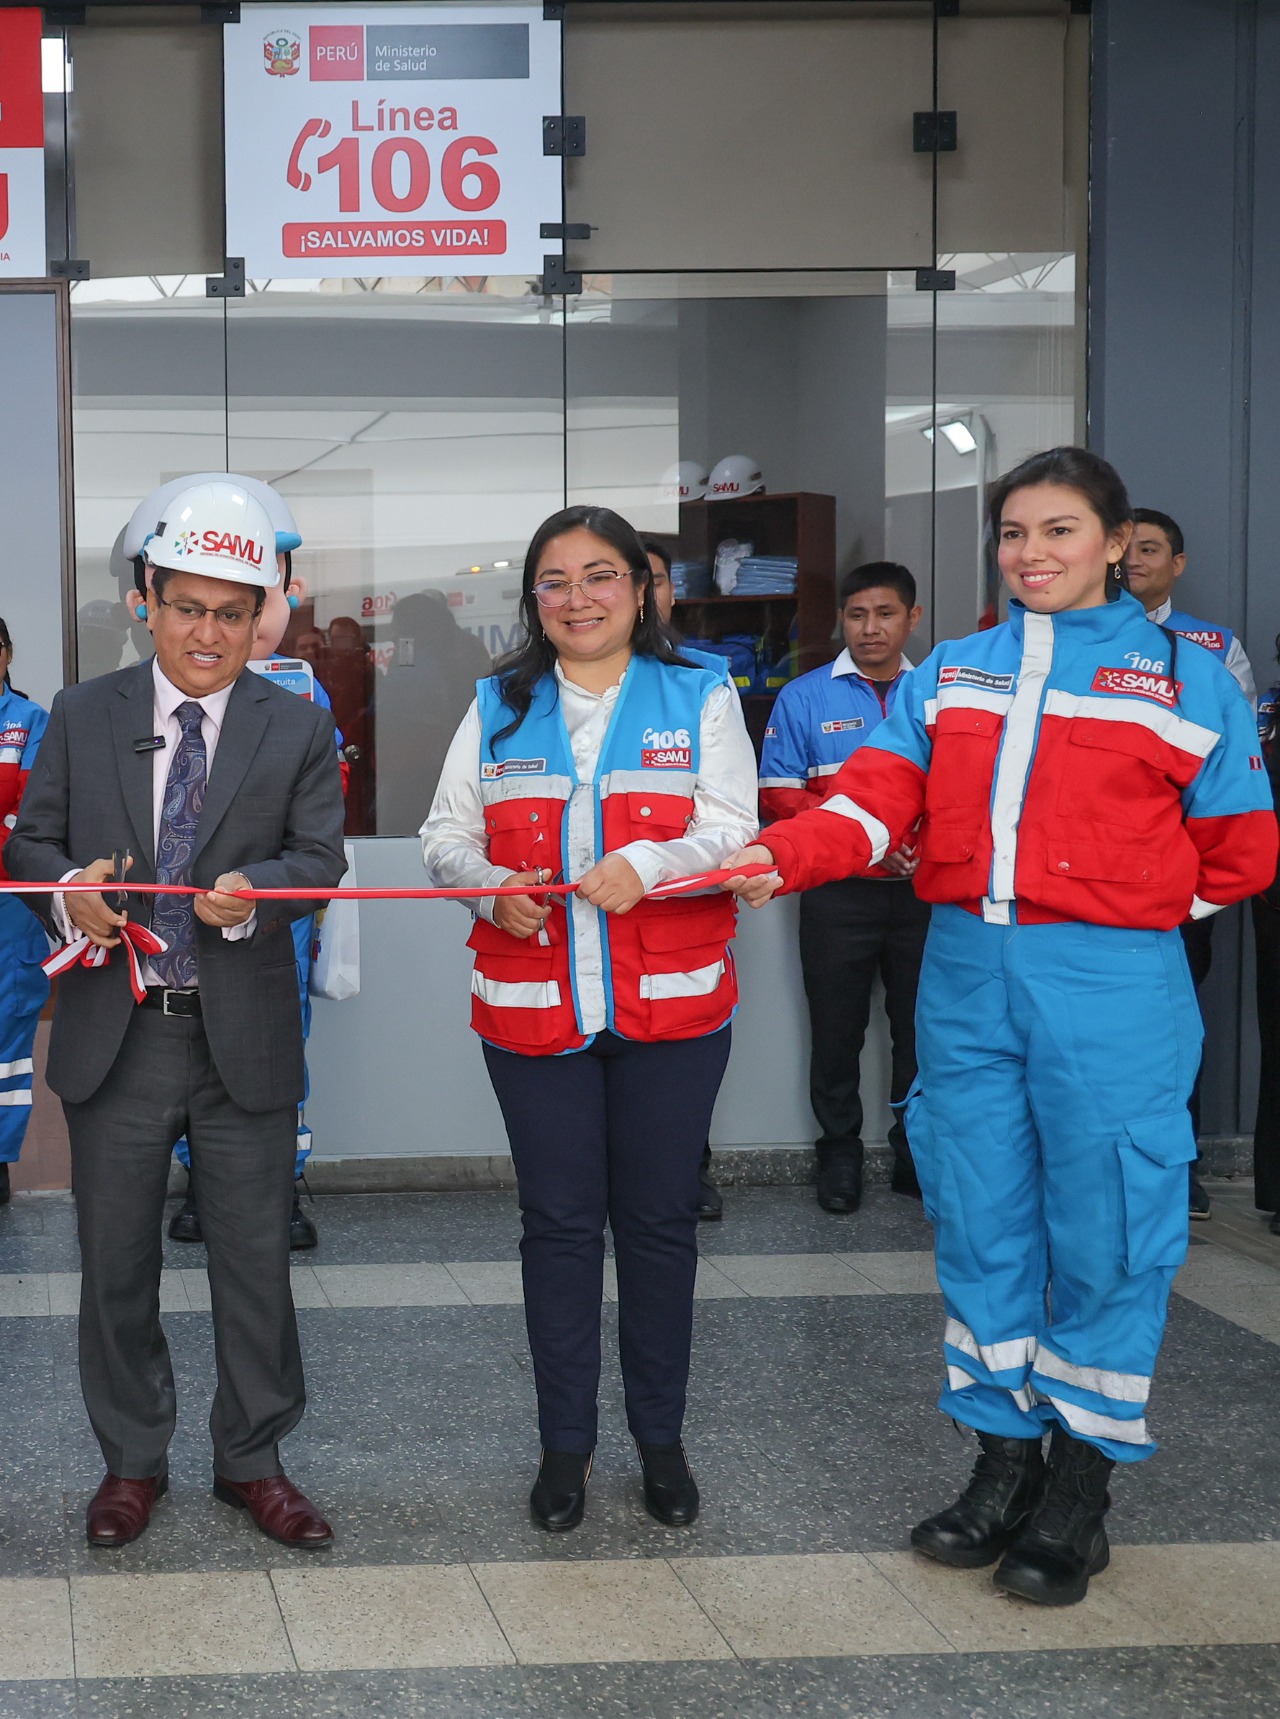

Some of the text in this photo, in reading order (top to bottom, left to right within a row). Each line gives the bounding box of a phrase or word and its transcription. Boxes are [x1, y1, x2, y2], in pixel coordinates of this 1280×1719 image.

[316, 42, 358, 61] PERÚ
[375, 45, 437, 58] Ministerio
[375, 59, 427, 71] de Salud
[351, 99, 458, 131] Línea
[317, 136, 500, 213] 106
[299, 227, 490, 253] ¡SALVAMOS VIDA!
[713, 482, 740, 493] SAMU
[201, 530, 264, 565] SAMU
[1130, 656, 1165, 674] 106
[4, 731, 28, 742] SAMU
[648, 728, 691, 749] 106
[657, 750, 689, 763] SAMU
